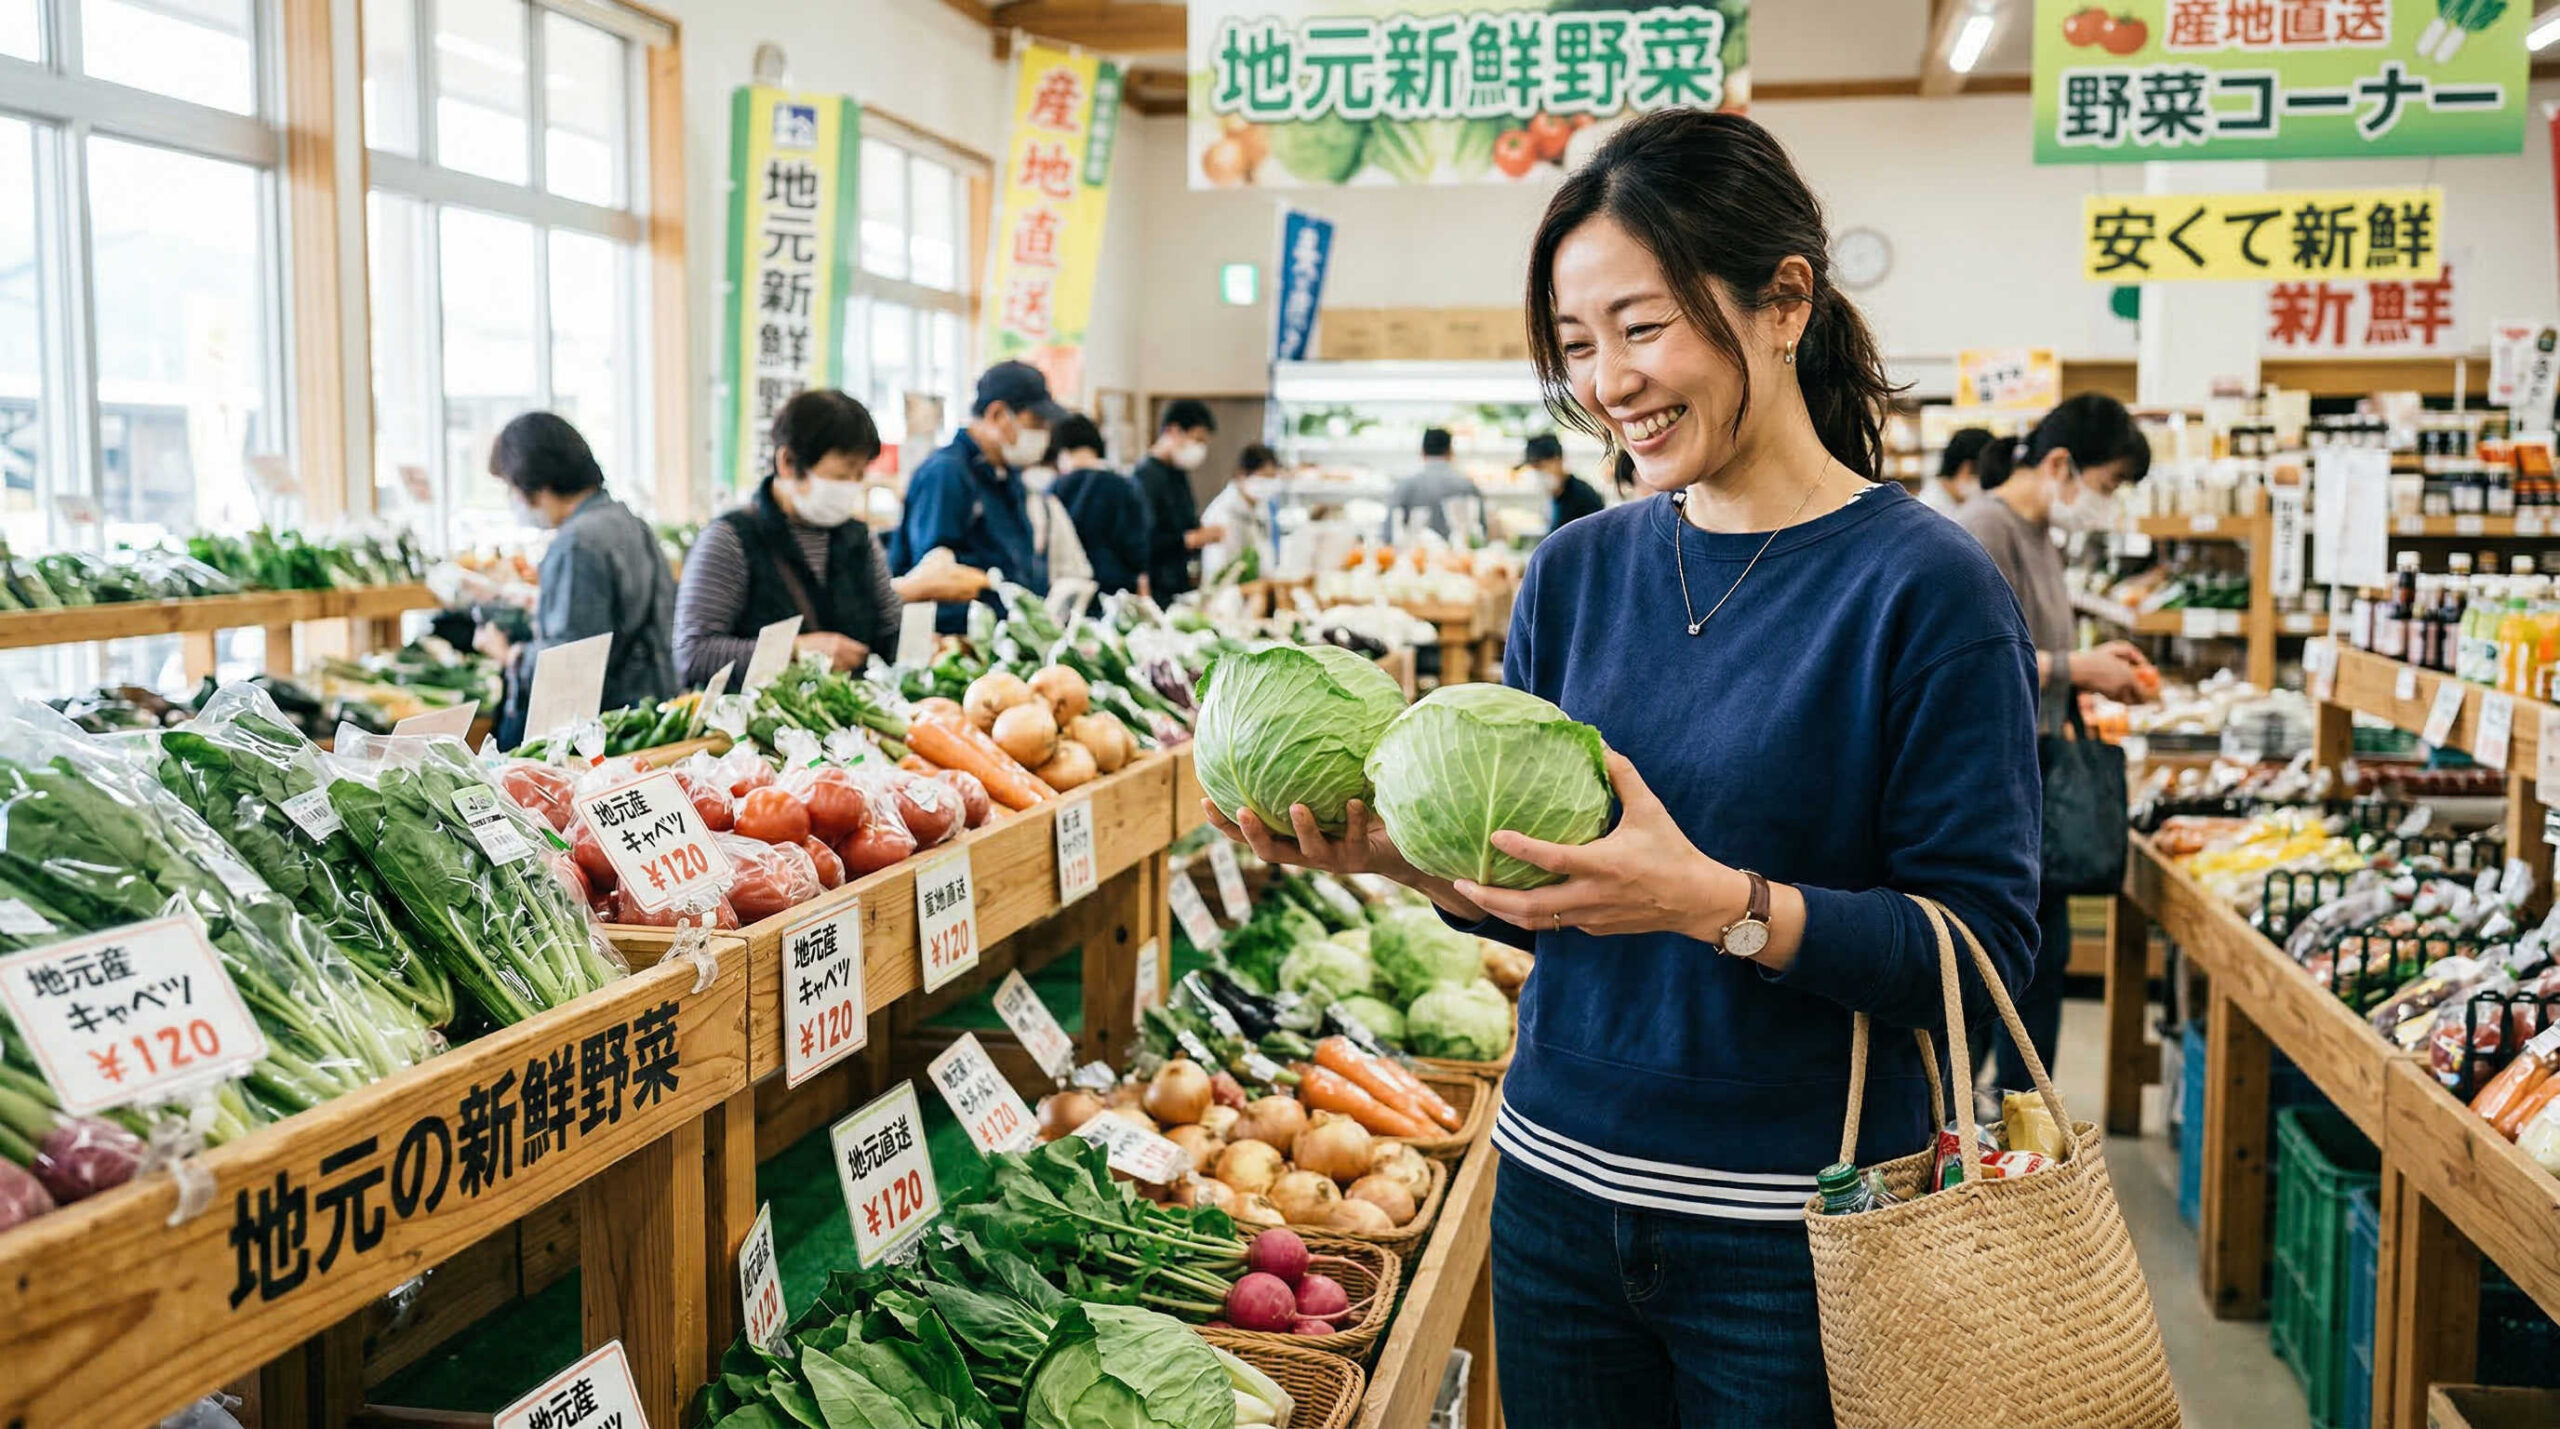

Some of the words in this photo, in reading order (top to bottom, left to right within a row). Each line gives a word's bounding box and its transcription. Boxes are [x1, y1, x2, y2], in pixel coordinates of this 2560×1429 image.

[2169, 0, 2387, 46] 産地直送
[1221, 17, 1713, 109] 地元新鮮野菜
[2065, 67, 2498, 140] 野菜コーナー
[1004, 70, 1079, 337] 産地直送
[2093, 202, 2433, 274] 安くて新鮮
[2268, 265, 2454, 345] 新鮮
[591, 789, 653, 829] 地元産
[621, 811, 686, 854] キャベツ
[640, 843, 709, 892] ¥120
[26, 946, 137, 998] 地元産
[794, 923, 839, 970] 地元産
[930, 919, 969, 969] ¥120
[66, 974, 192, 1034] キャベツ
[799, 957, 851, 1007] キャベツ
[87, 1018, 221, 1084] ¥120
[800, 999, 853, 1060] ¥120
[848, 1113, 913, 1182] 地元直送
[977, 1101, 1019, 1146] ¥120
[229, 1000, 681, 1310] 地元の新鮮野菜
[862, 1169, 923, 1237] ¥120
[751, 1278, 778, 1345] ¥120
[529, 1377, 599, 1429] 地元産
